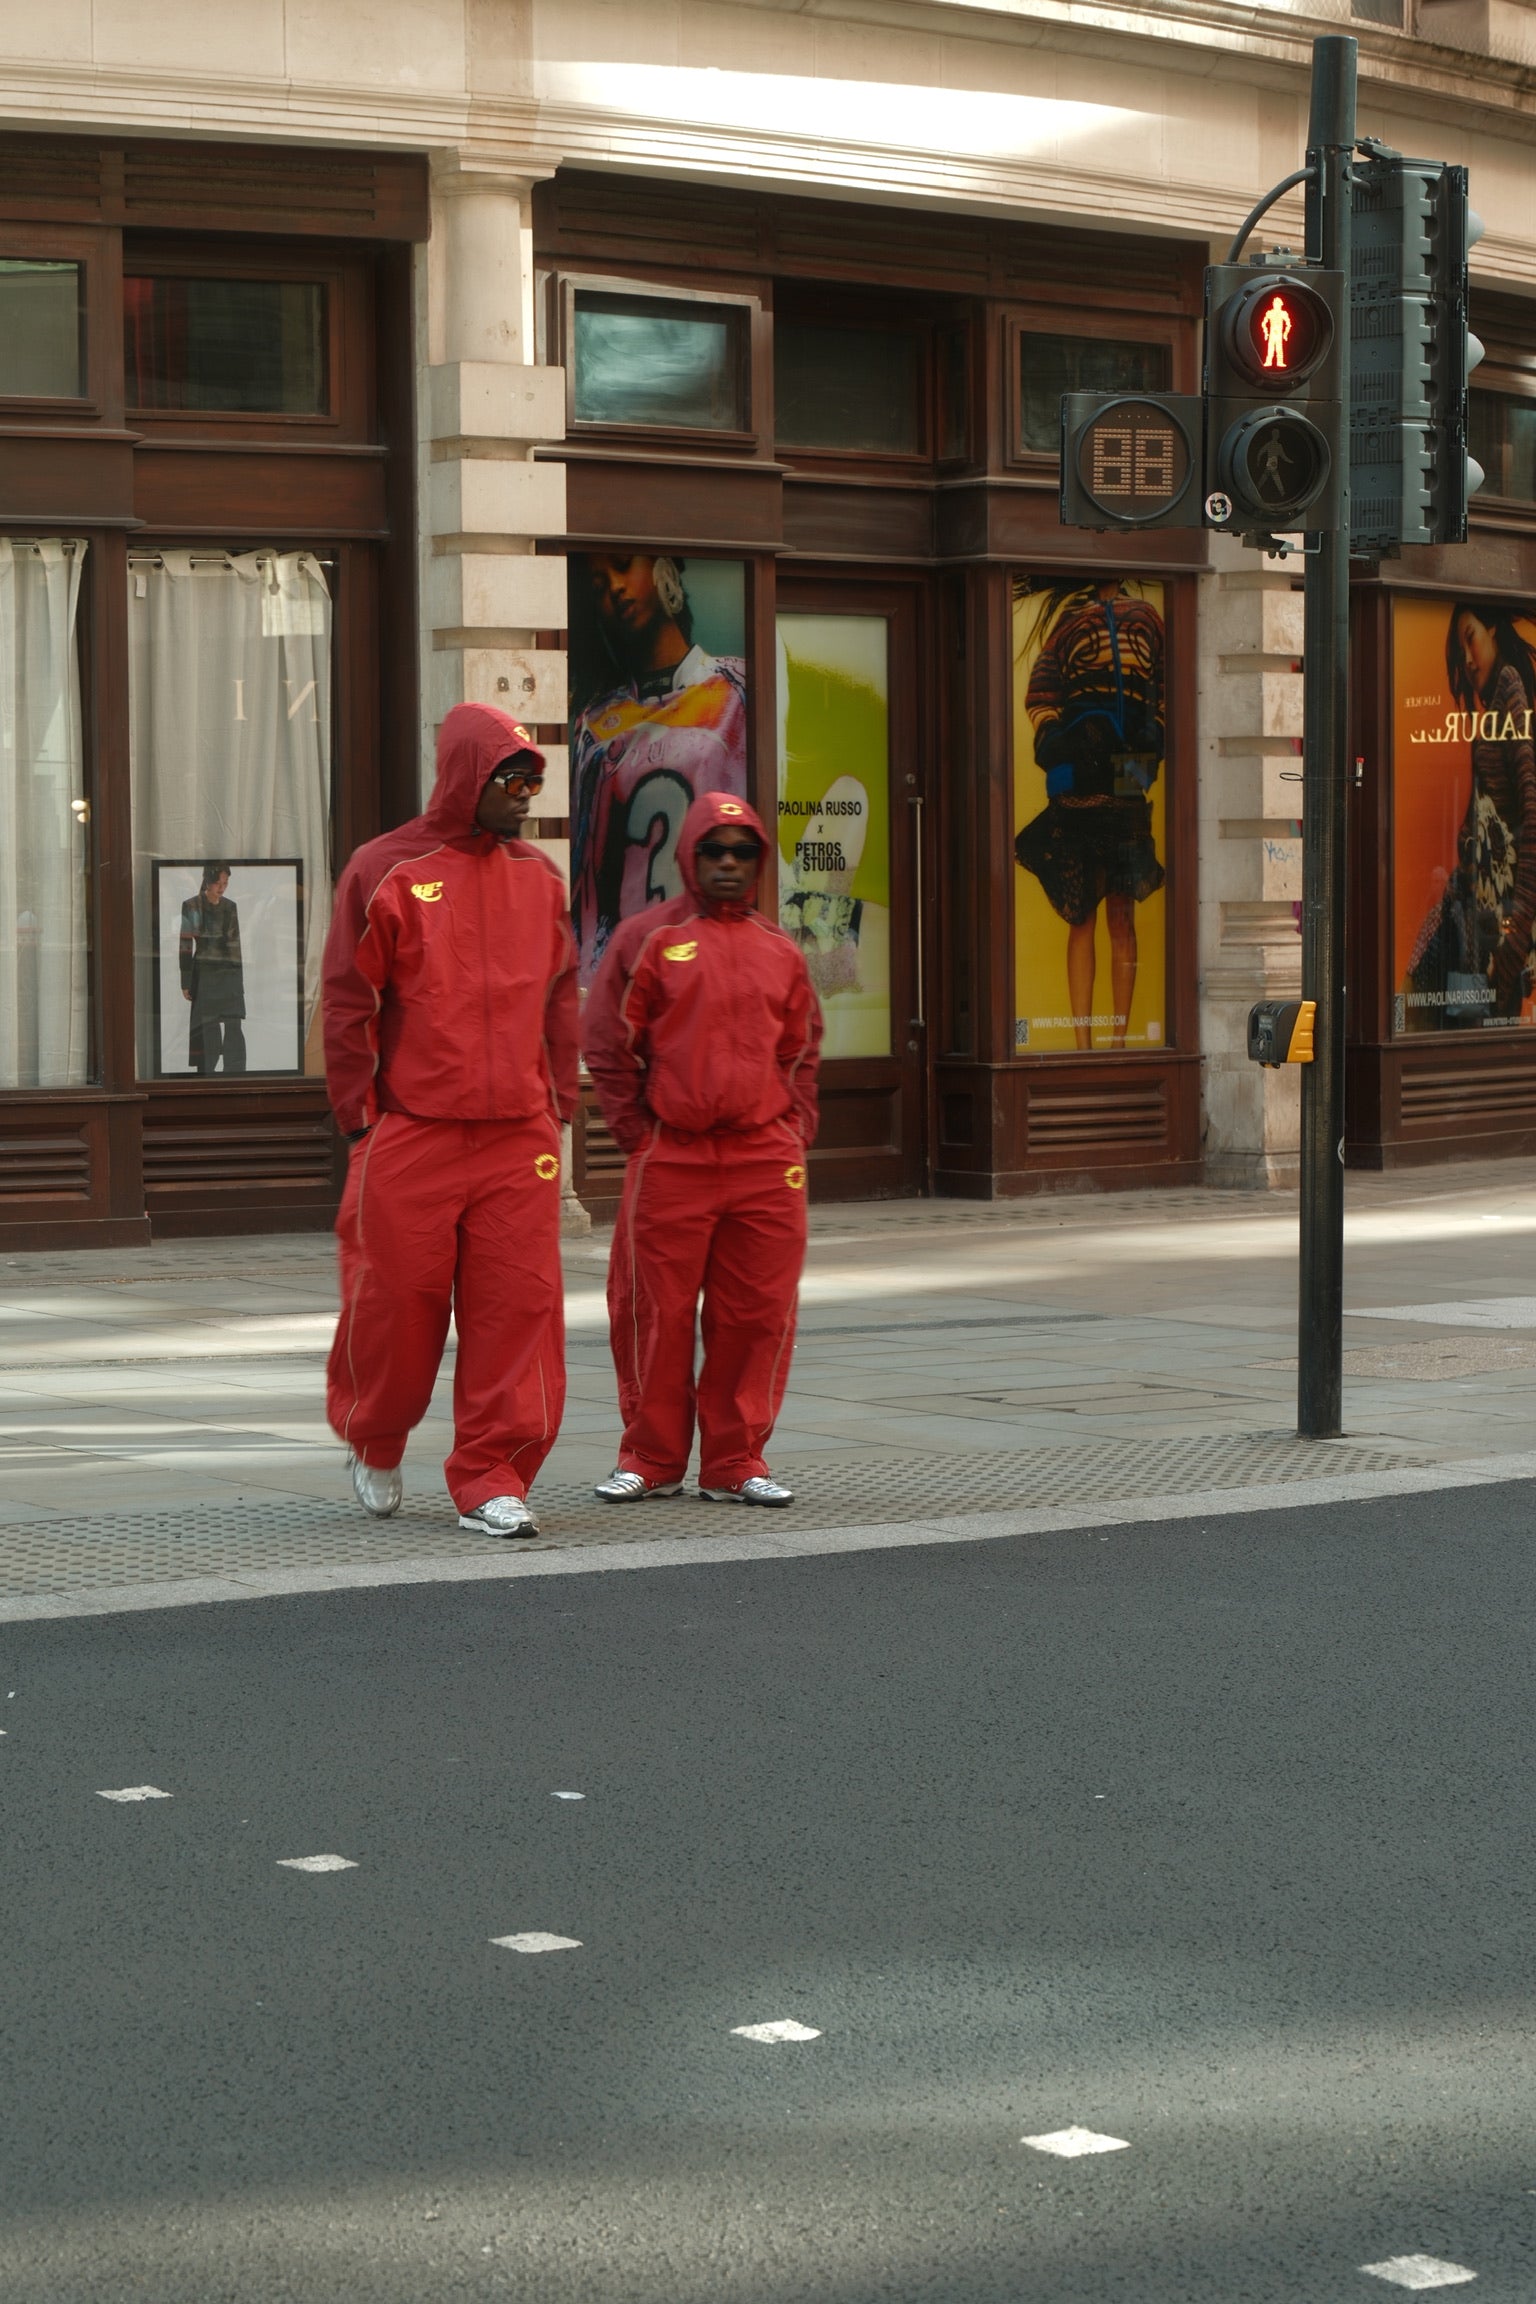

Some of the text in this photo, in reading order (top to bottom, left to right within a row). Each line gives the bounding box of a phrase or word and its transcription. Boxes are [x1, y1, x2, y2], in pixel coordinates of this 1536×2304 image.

[778, 801, 861, 815] PAOLINA RUSSO
[796, 842, 841, 857] PETROS
[803, 857, 845, 871] STUDIO
[1407, 989, 1496, 1007] WWW.PAOLINARUSSO.COM
[1032, 1016, 1126, 1028] WWW.PAOLINARUSSO.COM
